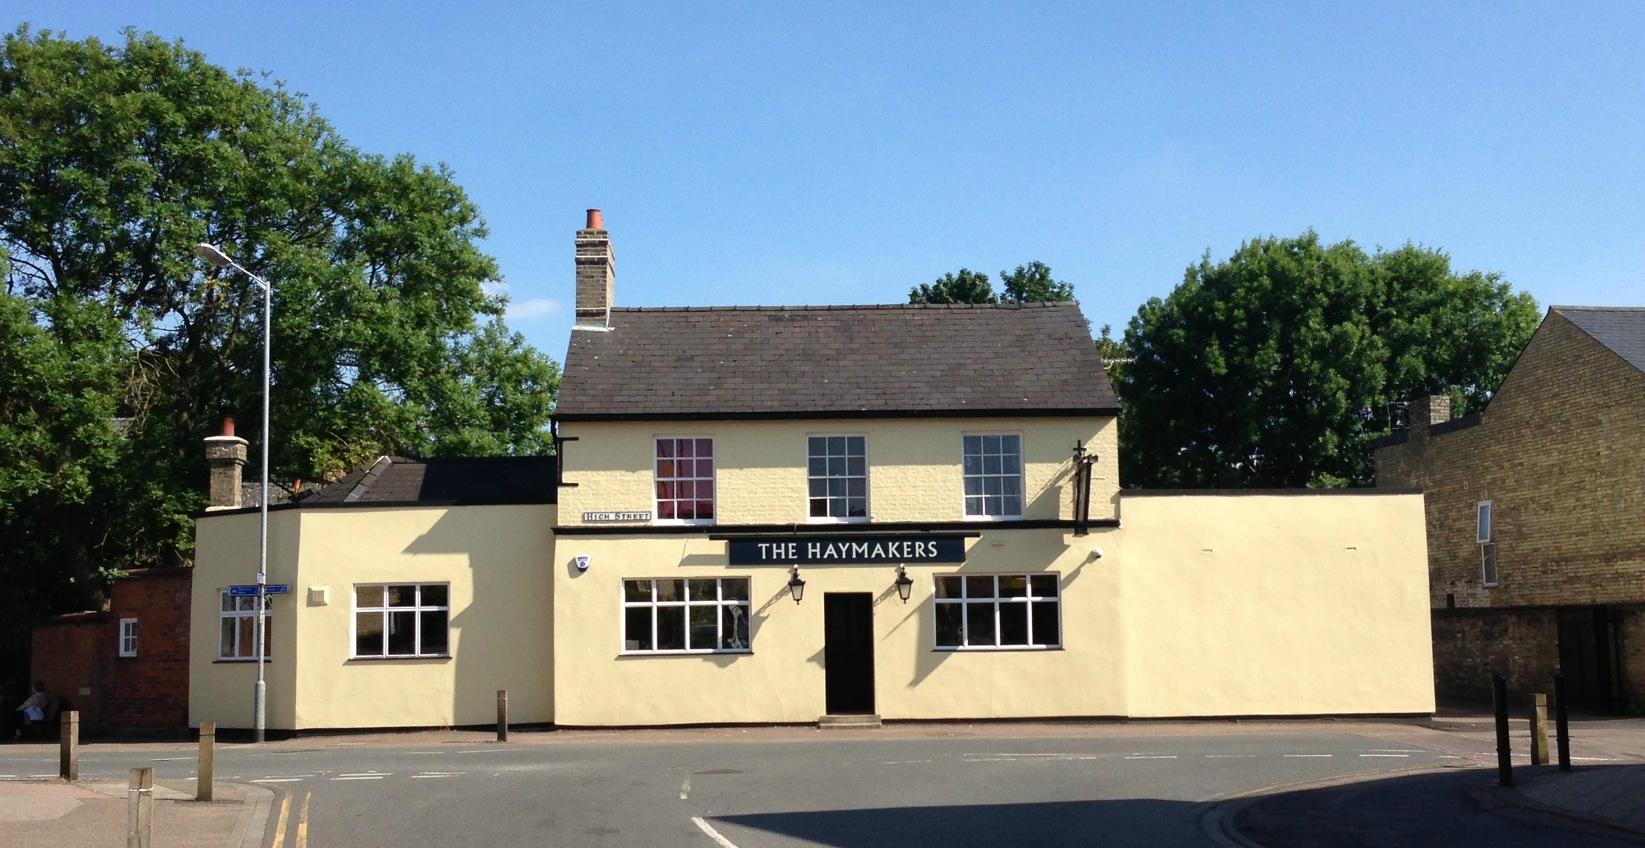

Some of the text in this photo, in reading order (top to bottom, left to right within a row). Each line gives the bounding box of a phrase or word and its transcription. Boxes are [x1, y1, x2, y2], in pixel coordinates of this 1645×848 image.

[586, 512, 649, 520] HIGH STREET
[758, 541, 938, 559] THE HAYMAKERS
